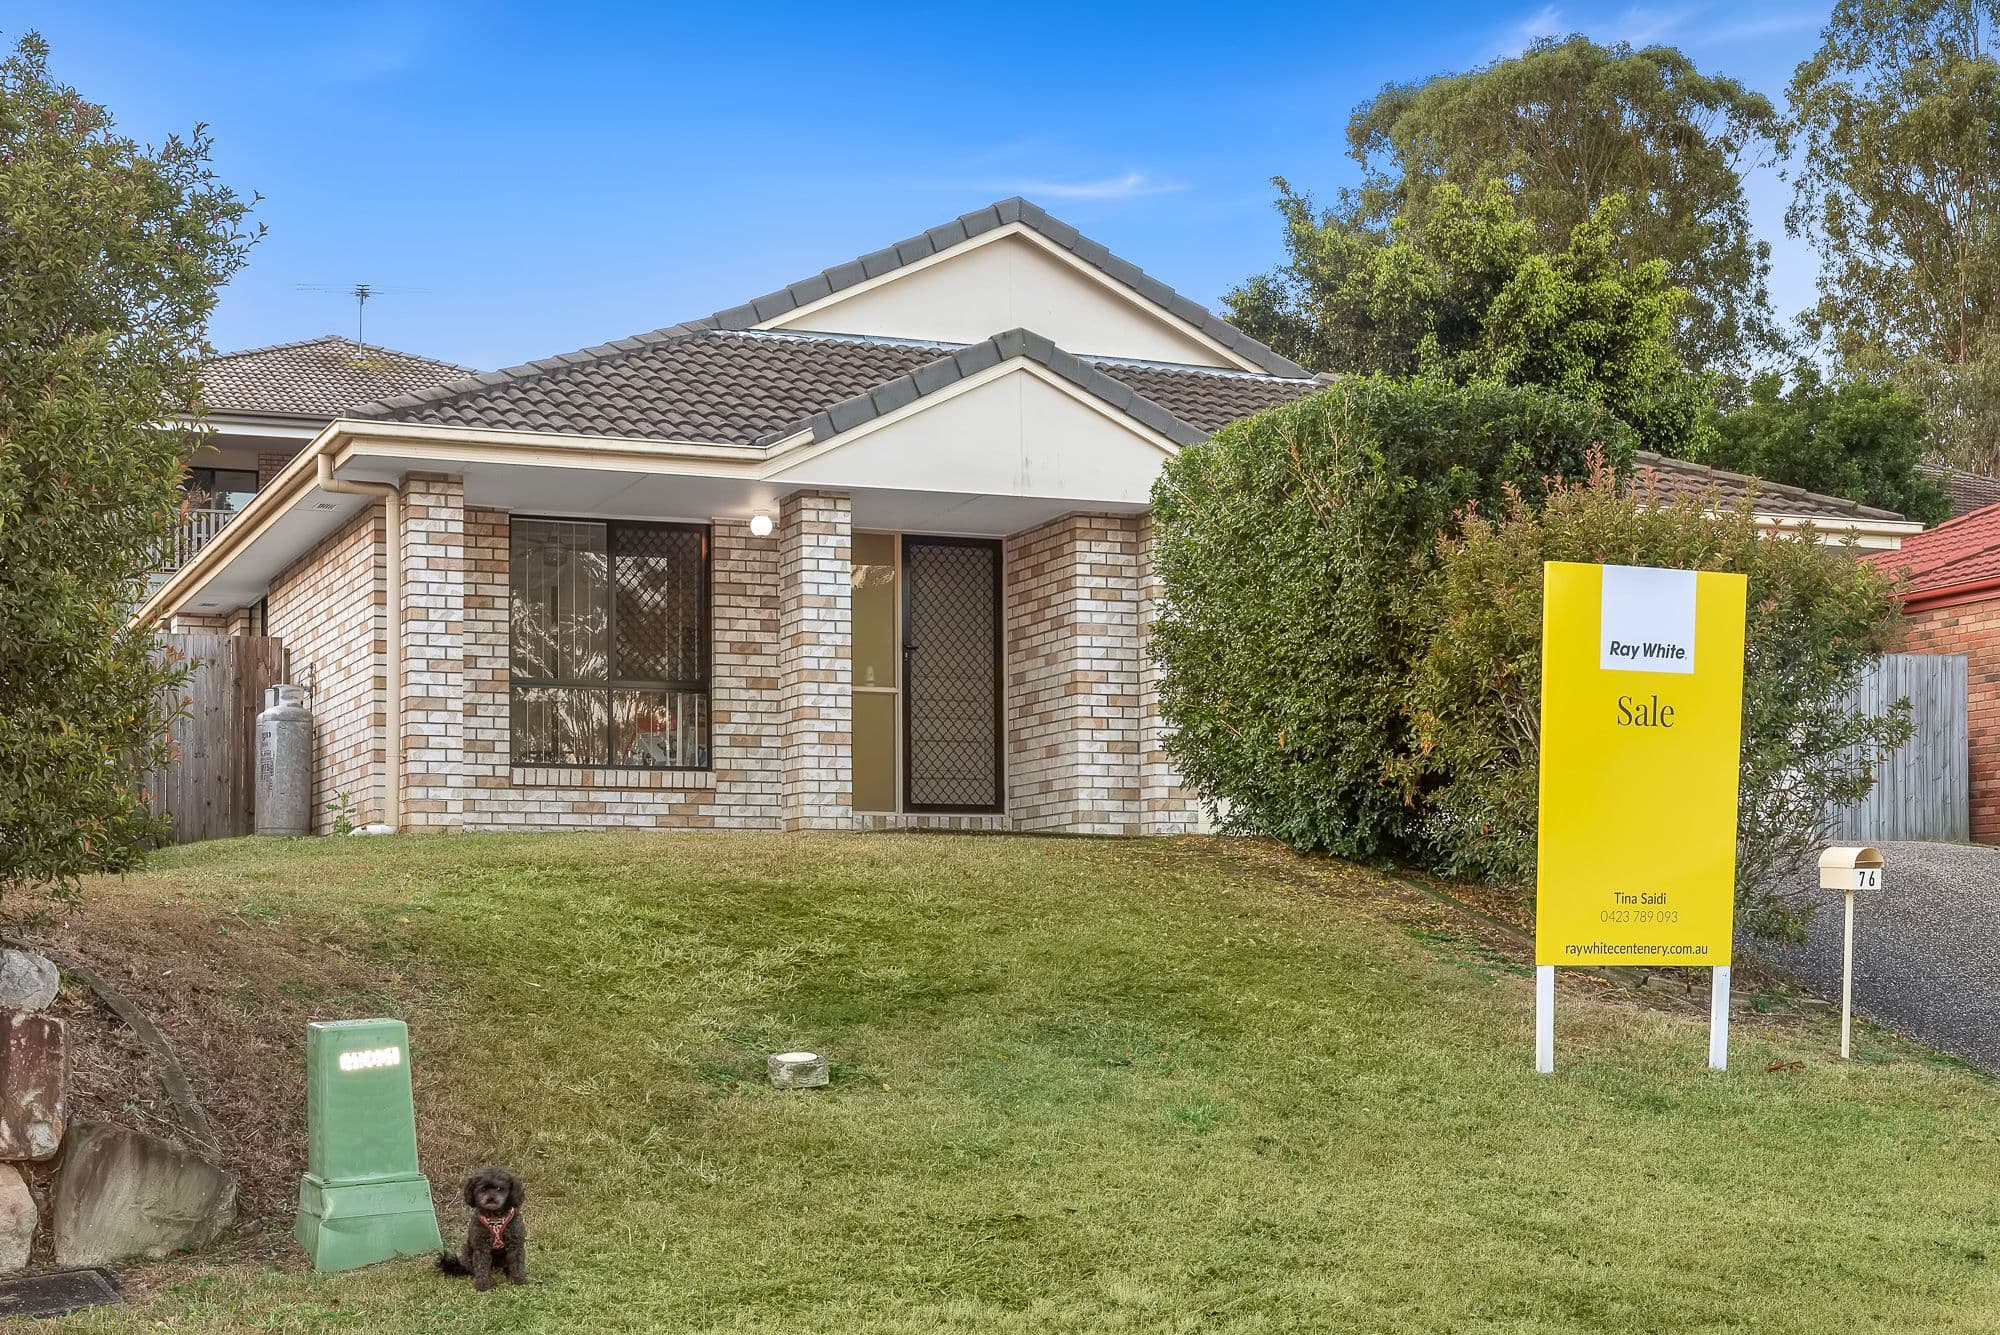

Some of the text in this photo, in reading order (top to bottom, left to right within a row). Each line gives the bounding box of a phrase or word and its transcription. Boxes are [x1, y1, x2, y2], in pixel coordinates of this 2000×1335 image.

[1609, 641, 1685, 660] Ray White
[1617, 695, 1674, 728] Sale
[1859, 871, 1874, 887] 76
[1614, 892, 1667, 905] Tina Saidi
[1600, 910, 1678, 923] 0423 789 093
[1565, 941, 1708, 957] raywhitecentenery.com.au
